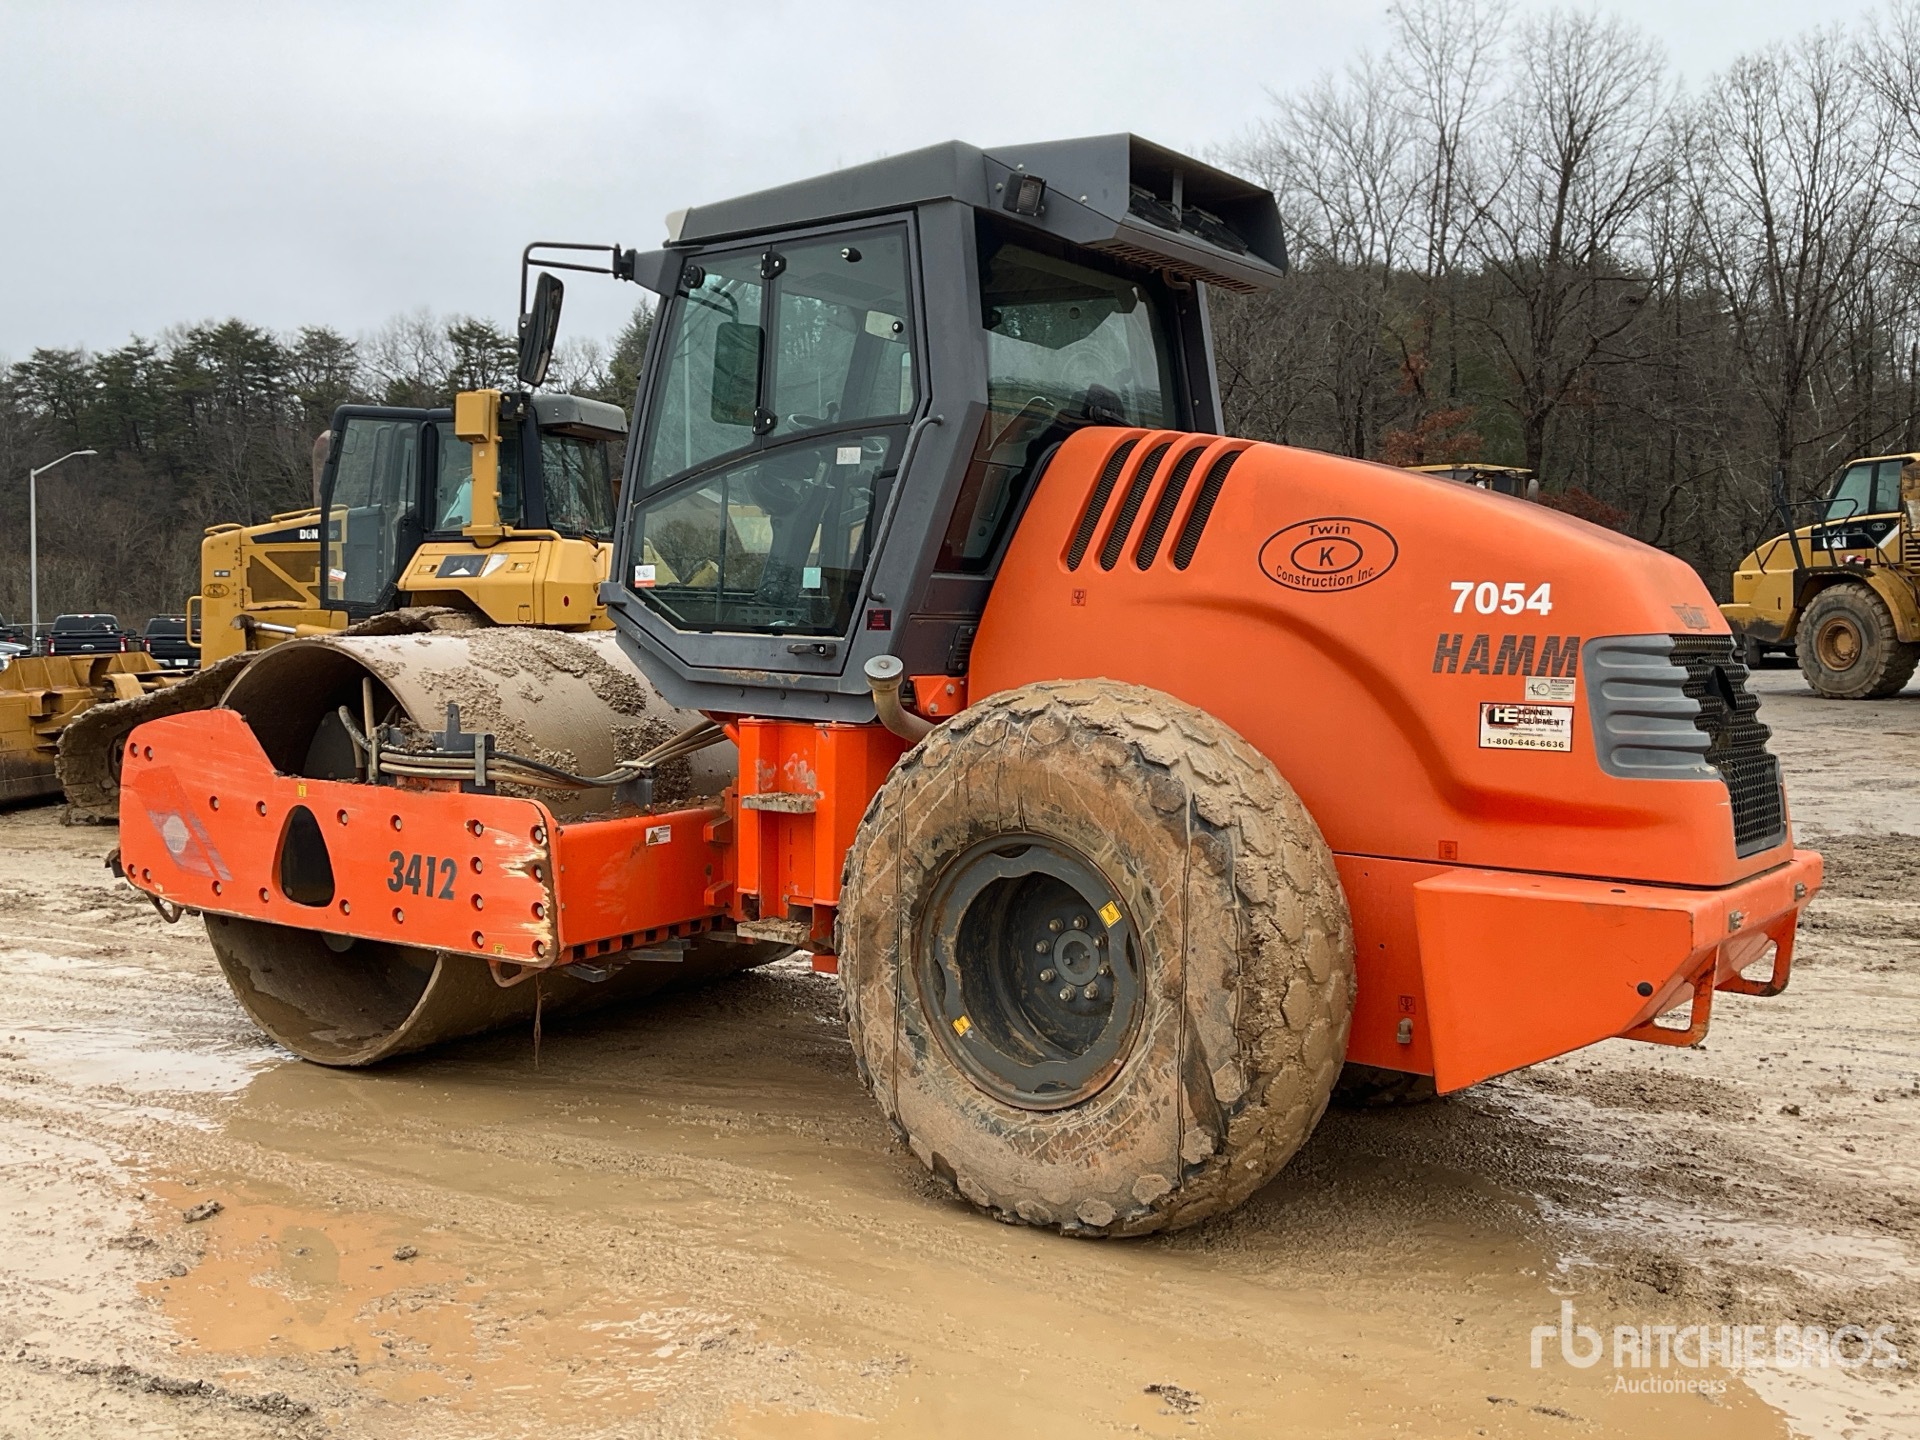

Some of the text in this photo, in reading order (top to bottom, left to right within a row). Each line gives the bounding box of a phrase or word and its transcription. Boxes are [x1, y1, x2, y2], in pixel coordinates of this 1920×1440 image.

[299, 529, 319, 539] D6N
[1308, 523, 1351, 535] Twin
[1319, 546, 1335, 566] K
[1276, 565, 1375, 587] Construction Inc.
[1450, 582, 1553, 616] 7054
[1432, 633, 1580, 677] HAMM
[1518, 717, 1565, 726] EQUIPMENT
[1487, 737, 1564, 748] 1-800-646-6636
[387, 850, 457, 900] 3412
